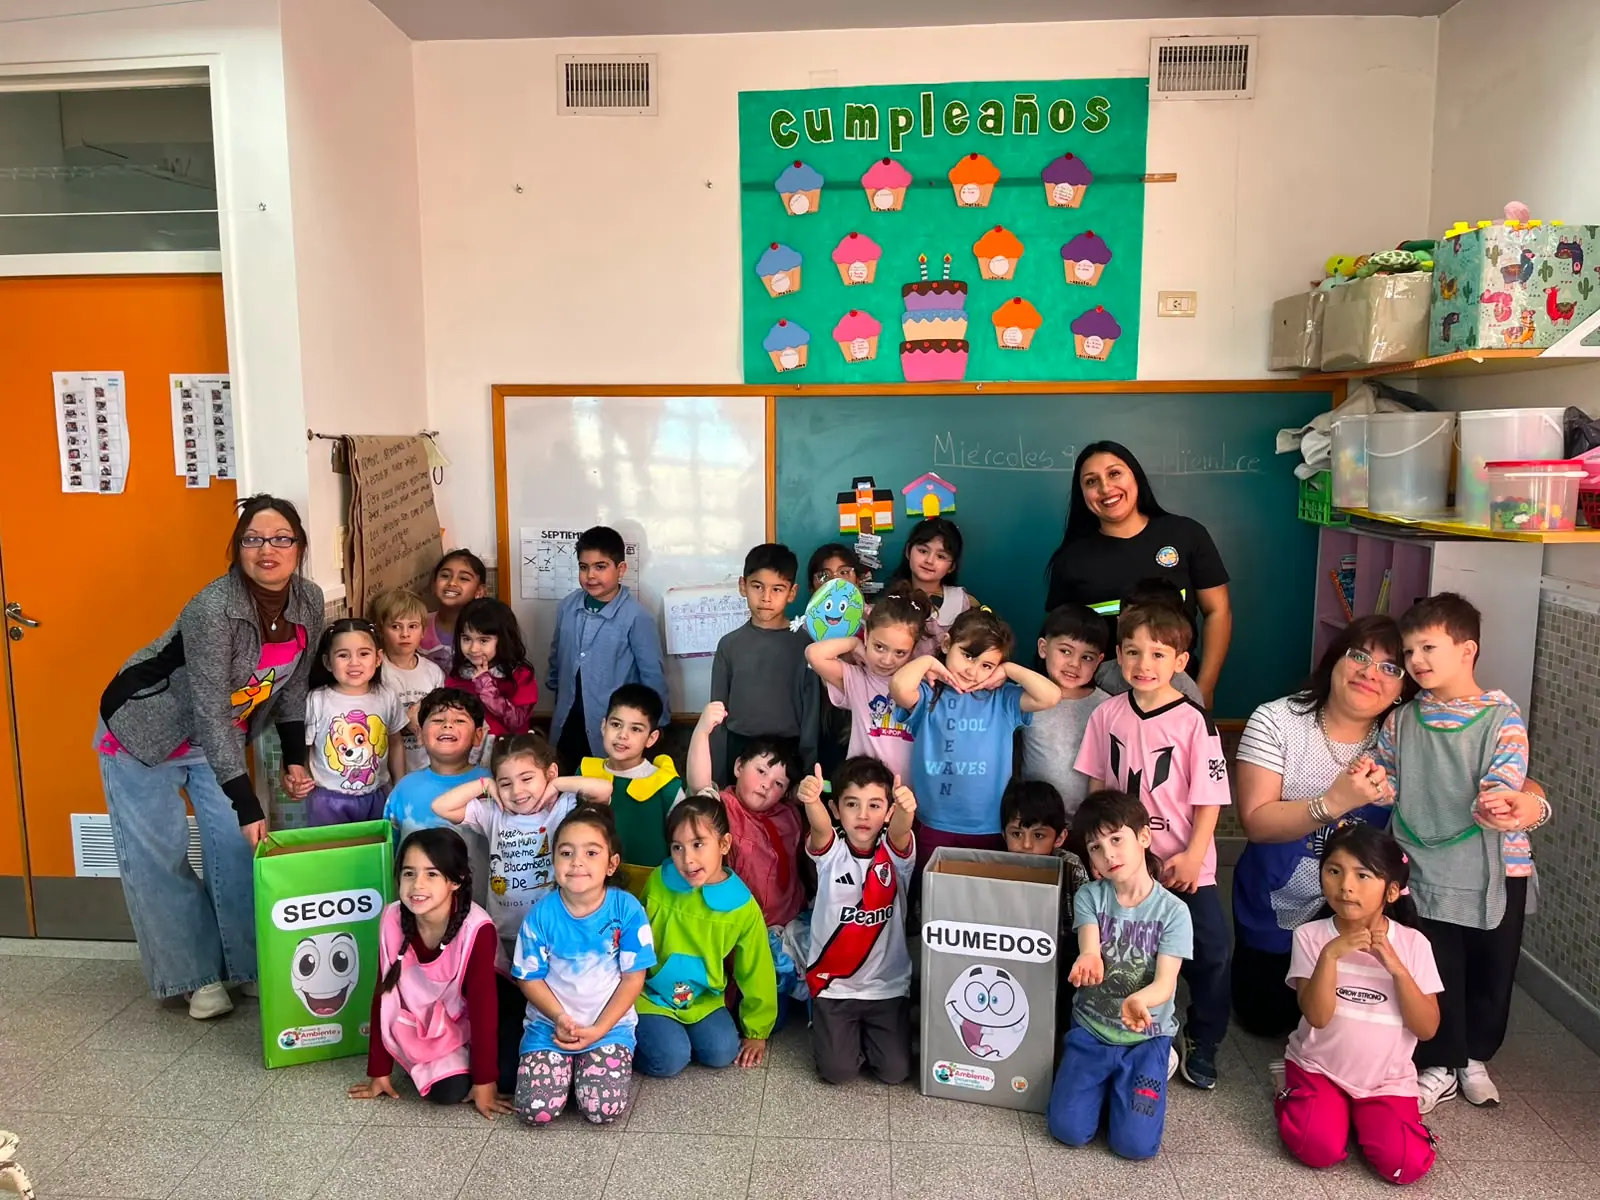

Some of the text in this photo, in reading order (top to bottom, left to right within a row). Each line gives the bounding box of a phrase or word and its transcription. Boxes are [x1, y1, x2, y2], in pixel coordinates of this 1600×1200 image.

[769, 92, 1111, 152] cumpleaños
[934, 431, 1054, 469] Miércoles
[541, 530, 583, 540] SEPTIEM
[947, 718, 987, 732] COOL
[925, 760, 987, 776] WAVES
[512, 877, 527, 889] De
[283, 895, 372, 923] SECOS
[926, 925, 1052, 957] HUMEDOS
[1339, 988, 1357, 997] GROW
[1358, 991, 1382, 1001] STRONG
[301, 1029, 336, 1038] Ambiente
[955, 1070, 990, 1081] Ambiente
